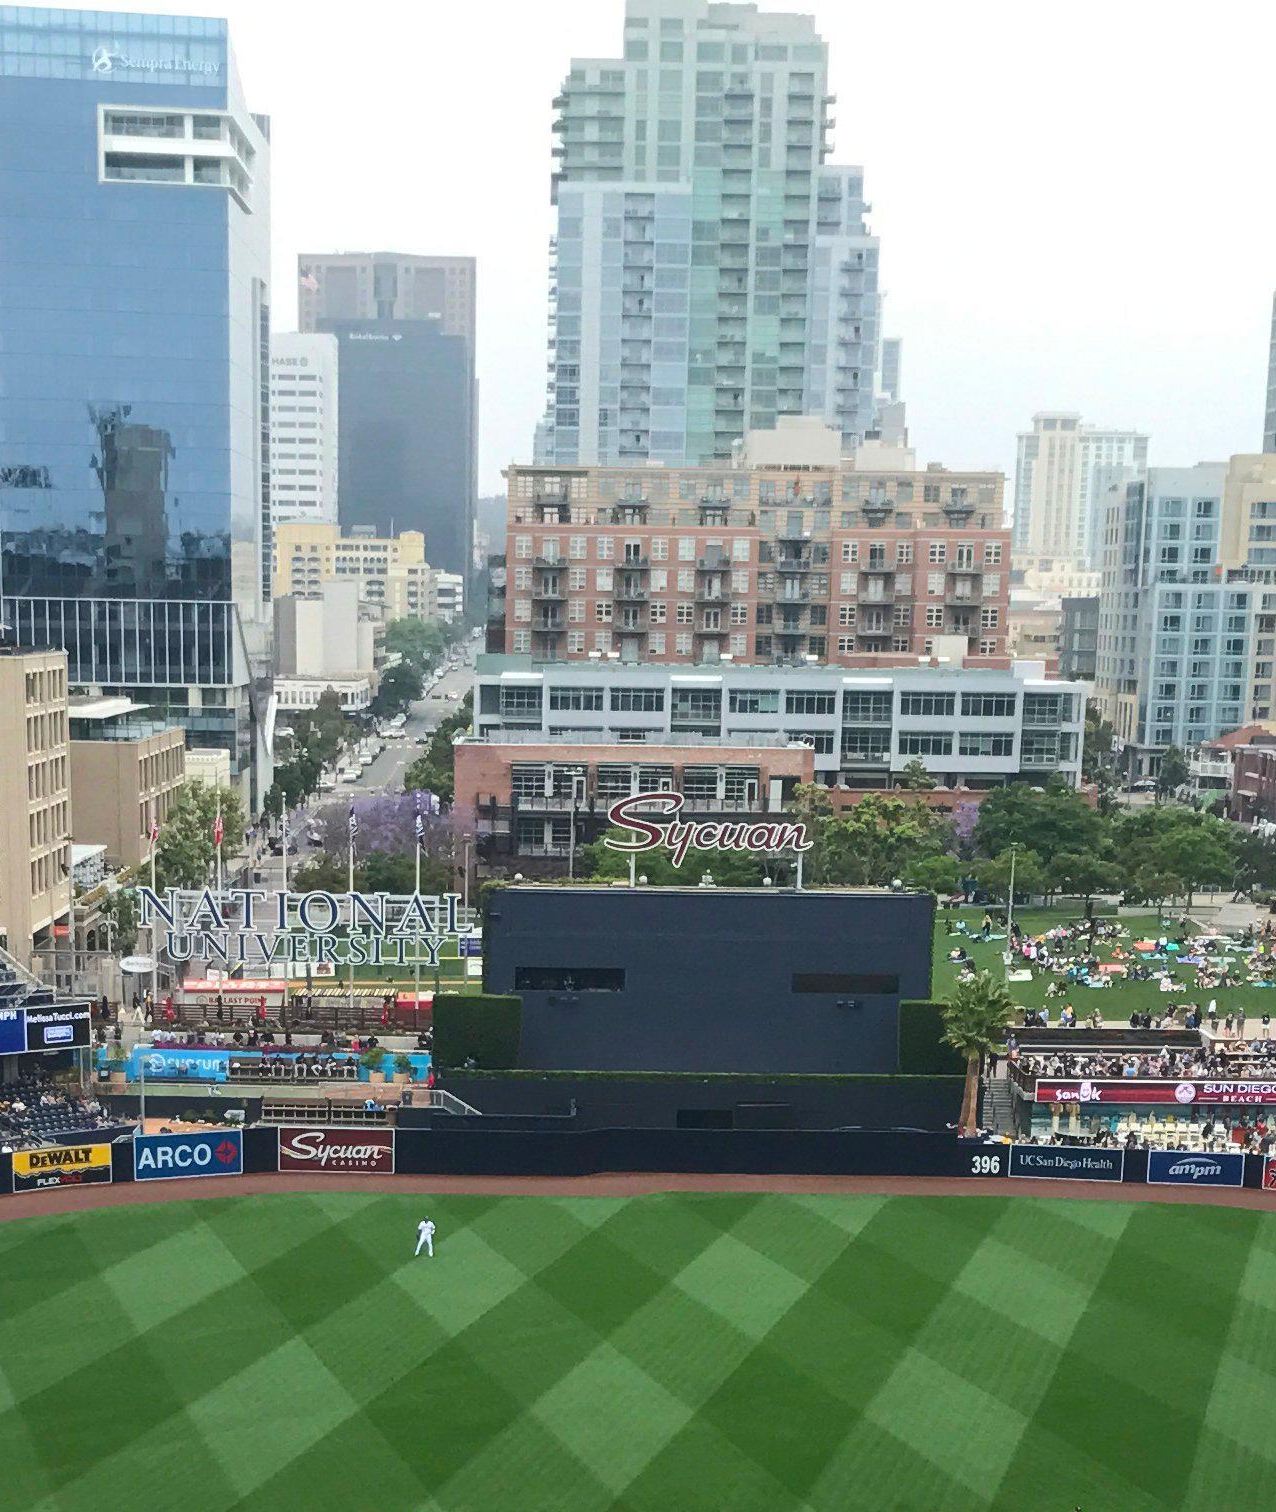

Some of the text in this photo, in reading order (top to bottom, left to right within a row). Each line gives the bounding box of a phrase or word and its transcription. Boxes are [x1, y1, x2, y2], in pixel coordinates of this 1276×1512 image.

[174, 57, 221, 74] Energy
[604, 791, 814, 868] Sycuan
[135, 885, 475, 937] NATIONAL
[165, 930, 449, 966] UNIVERSITY
[1203, 1084, 1236, 1093] SUN
[1222, 1095, 1262, 1103] BEACH
[137, 1143, 212, 1170] ARCO
[291, 1131, 384, 1167] Sycuan
[331, 1159, 377, 1167] CASINO
[971, 1155, 1000, 1174] 396
[1019, 1155, 1113, 1171] UC San Diego Health
[1168, 1162, 1222, 1180] ampm
